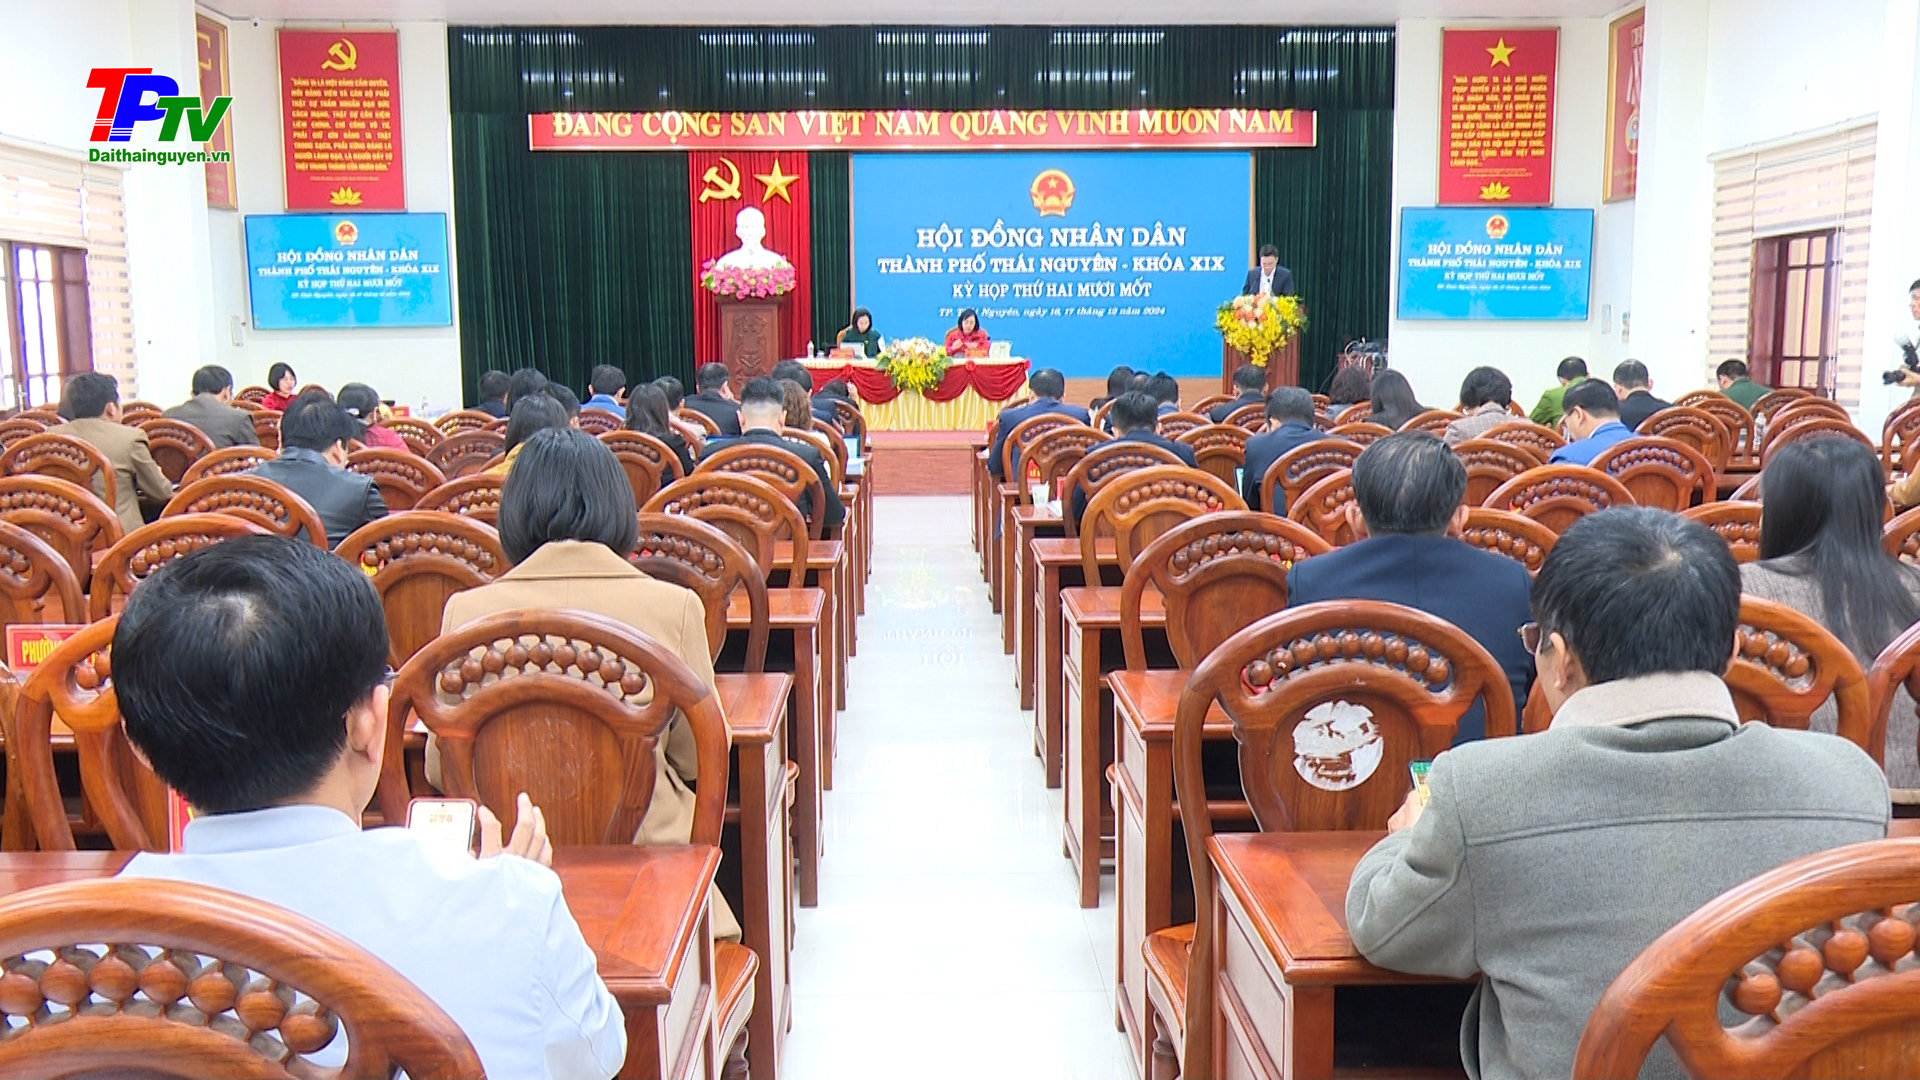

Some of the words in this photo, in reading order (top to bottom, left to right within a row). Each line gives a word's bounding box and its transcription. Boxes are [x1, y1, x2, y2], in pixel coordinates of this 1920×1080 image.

[873, 111, 941, 136] NAM
[950, 111, 1048, 141] QUANG
[1058, 111, 1130, 136] VINH
[916, 224, 963, 253] HỘI
[971, 218, 1043, 247] ĐỒNG
[1050, 222, 1124, 247] NHÂN
[1131, 221, 1186, 247] DÂN
[1428, 241, 1451, 256] HỘI
[1455, 240, 1491, 255] ĐỒNG
[1495, 241, 1531, 255] NHÂN
[1535, 242, 1563, 255] DÂN
[277, 250, 301, 264] HỘI
[305, 247, 343, 262] ĐỒNG
[347, 247, 386, 262] NHÂN
[389, 247, 418, 261] DÂN
[877, 254, 942, 274] THÀNH
[948, 251, 986, 274] PHỐ
[990, 254, 1035, 273] THÁI
[1040, 255, 1117, 273] NGUYÊN
[1132, 255, 1184, 272] KHÓA
[1189, 257, 1225, 272] XIX
[953, 281, 972, 297] KỲ
[978, 283, 1009, 303] HỌP
[1013, 279, 1043, 297] THỨ
[1047, 283, 1072, 297] HAI
[1119, 276, 1151, 297] MỐT
